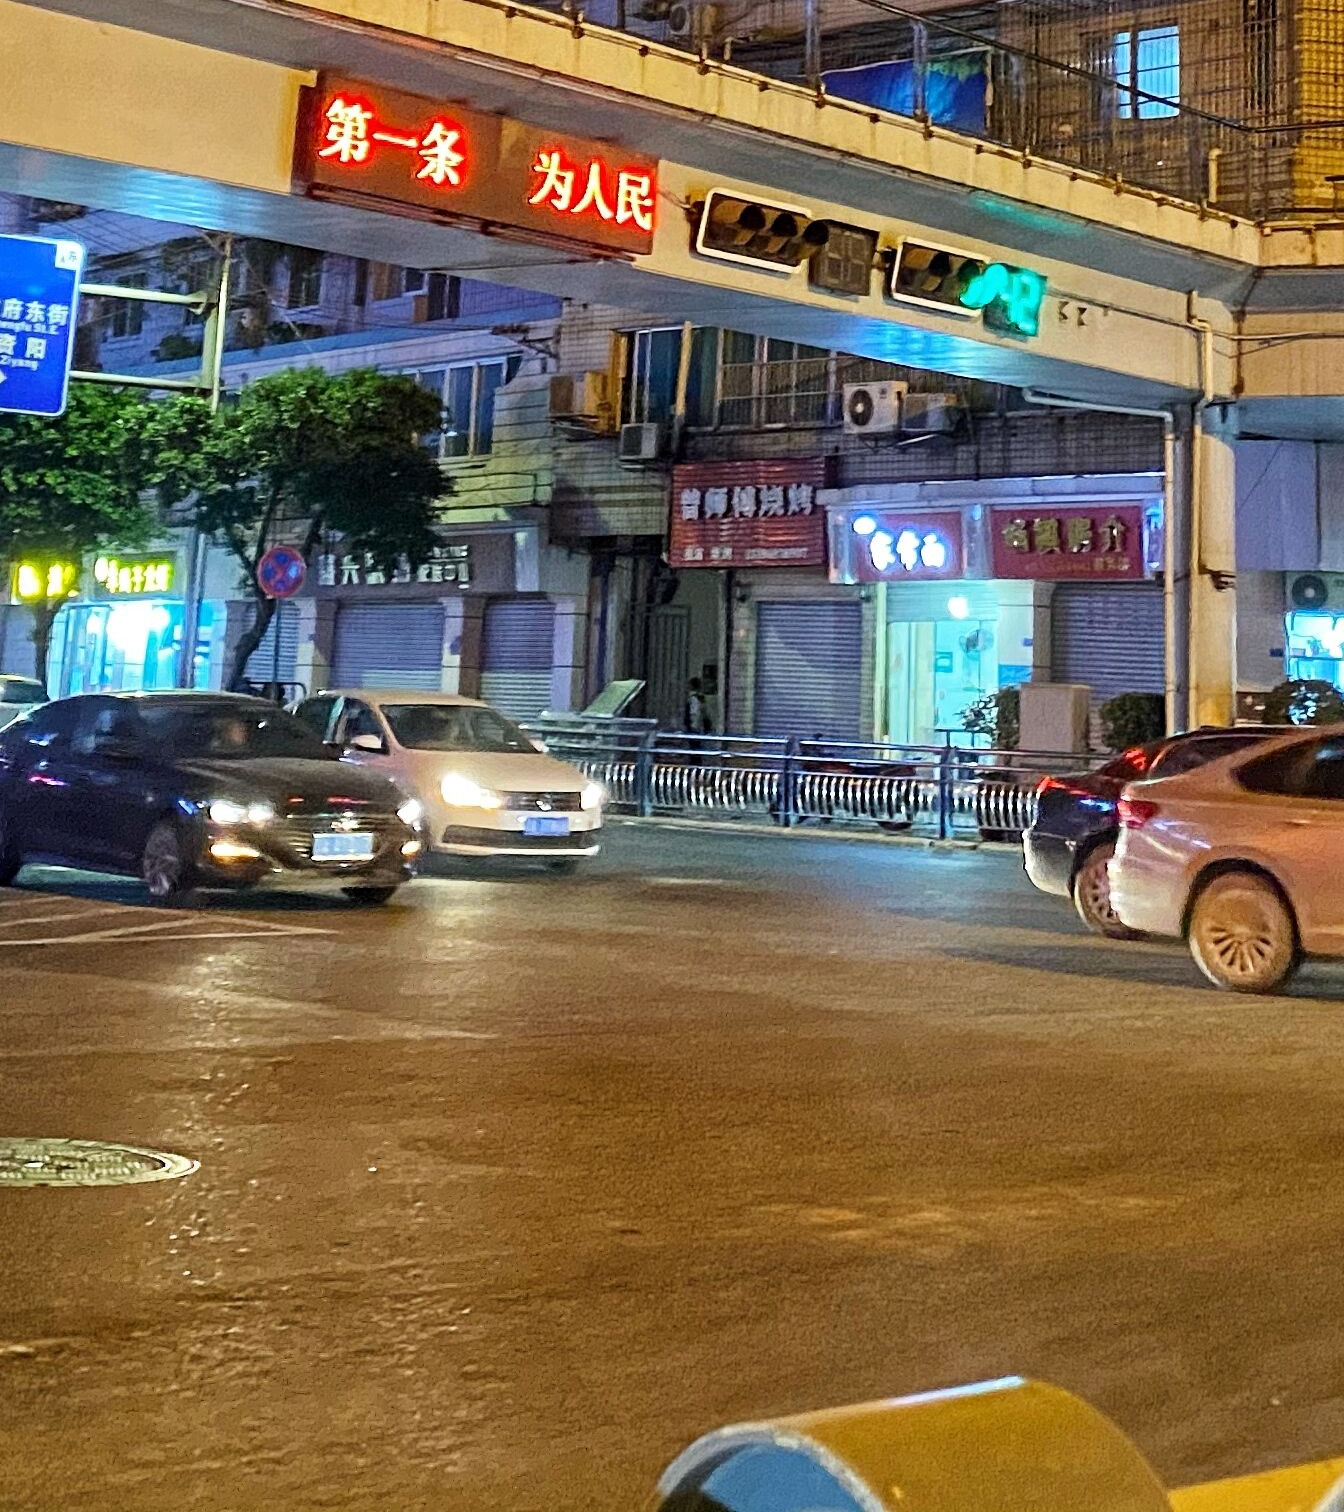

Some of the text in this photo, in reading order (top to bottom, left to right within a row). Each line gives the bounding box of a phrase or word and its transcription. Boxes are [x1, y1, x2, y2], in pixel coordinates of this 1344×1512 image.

[318, 97, 654, 232] 第一条 为人民
[680, 483, 813, 521] 曾师傅烧烤
